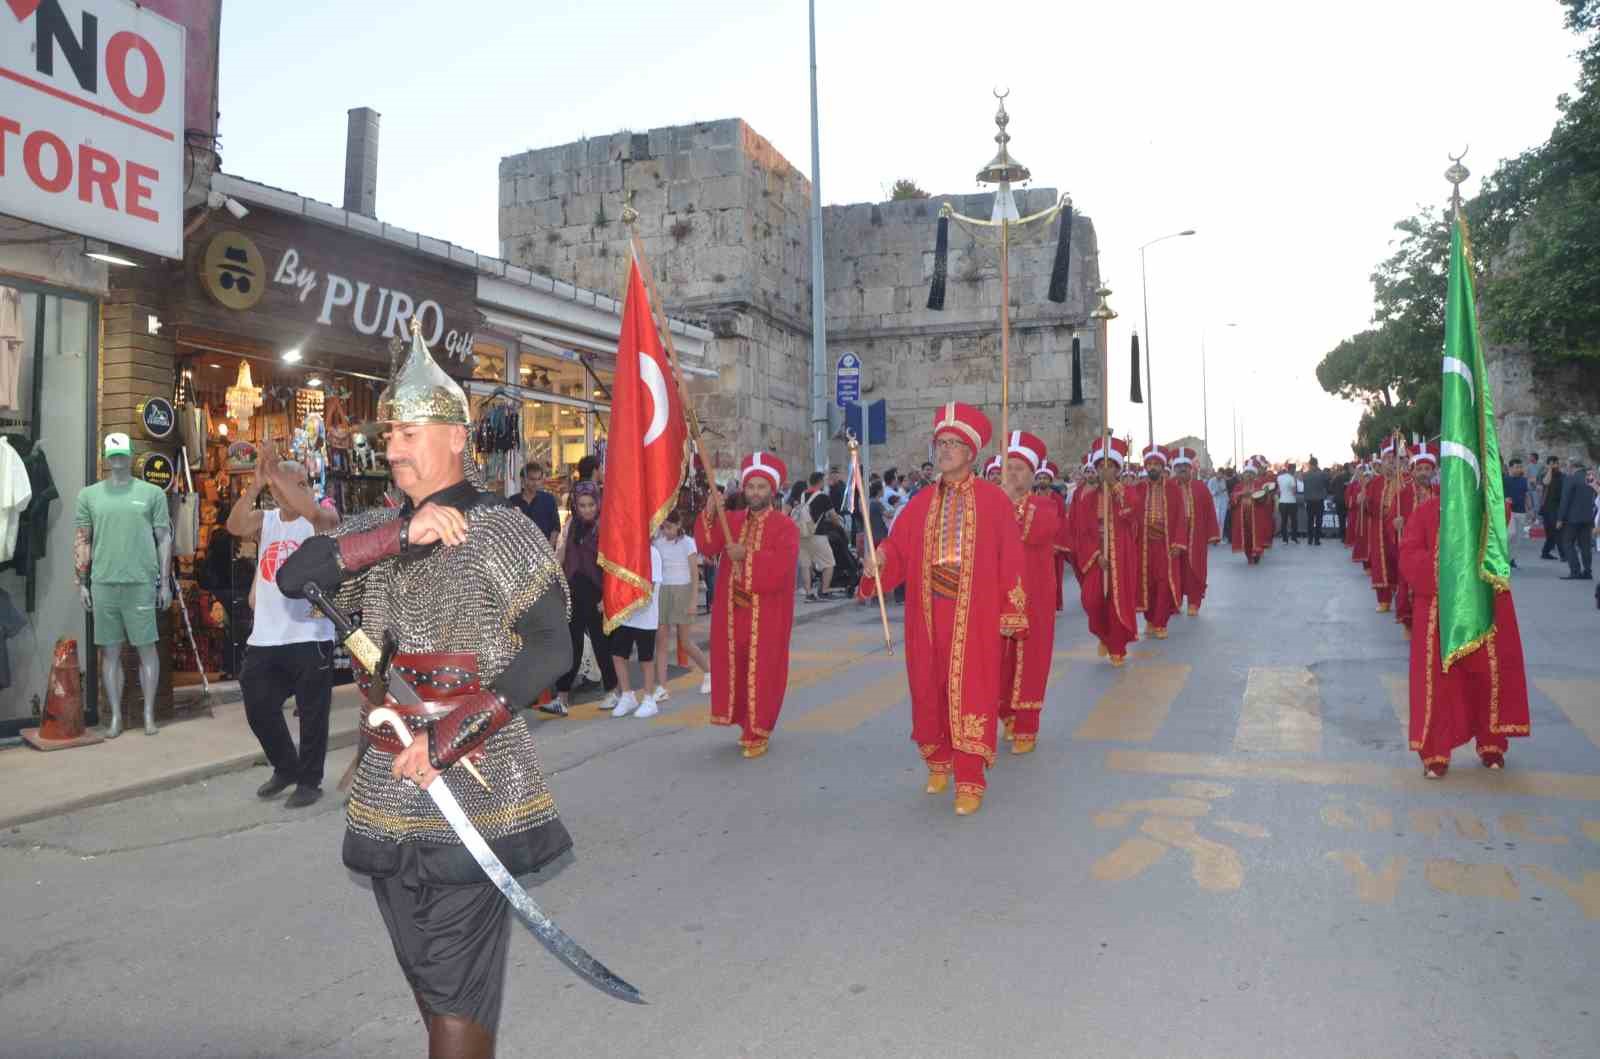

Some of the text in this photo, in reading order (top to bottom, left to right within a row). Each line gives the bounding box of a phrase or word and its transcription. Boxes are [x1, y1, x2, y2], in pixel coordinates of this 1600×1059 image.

[273, 249, 473, 362] By PURO Gift
